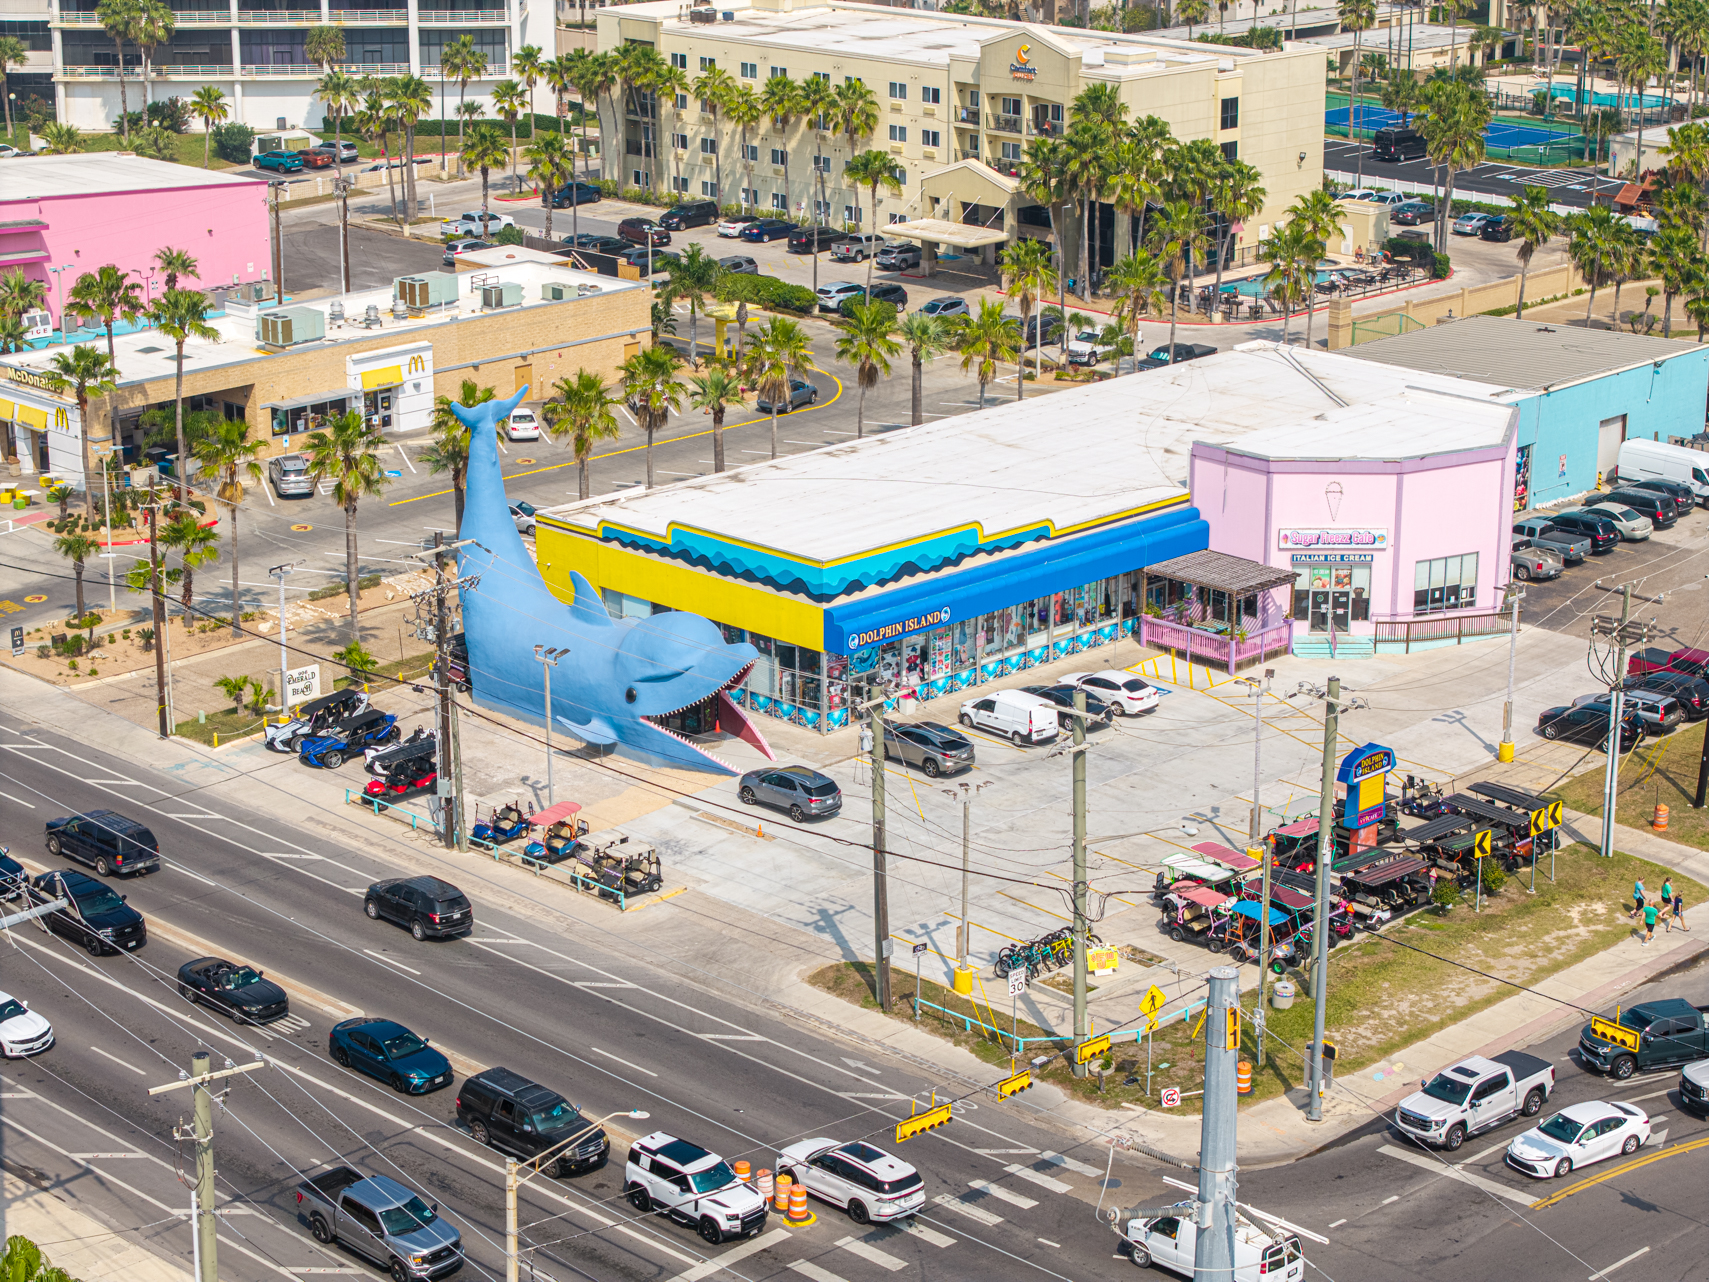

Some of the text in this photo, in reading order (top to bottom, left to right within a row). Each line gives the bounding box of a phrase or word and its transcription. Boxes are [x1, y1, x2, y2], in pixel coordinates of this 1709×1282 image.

[1291, 530, 1375, 547] Sugar Freezz Cafe
[859, 610, 941, 646] DOLPHIN ISLAND
[286, 671, 316, 685] EMERALD
[1361, 752, 1385, 768] DOLPHIN
[1362, 761, 1383, 775] ISLAND
[1010, 969, 1024, 979] SPEED
[1011, 975, 1023, 984] LIMIT
[1010, 981, 1024, 994] 30
